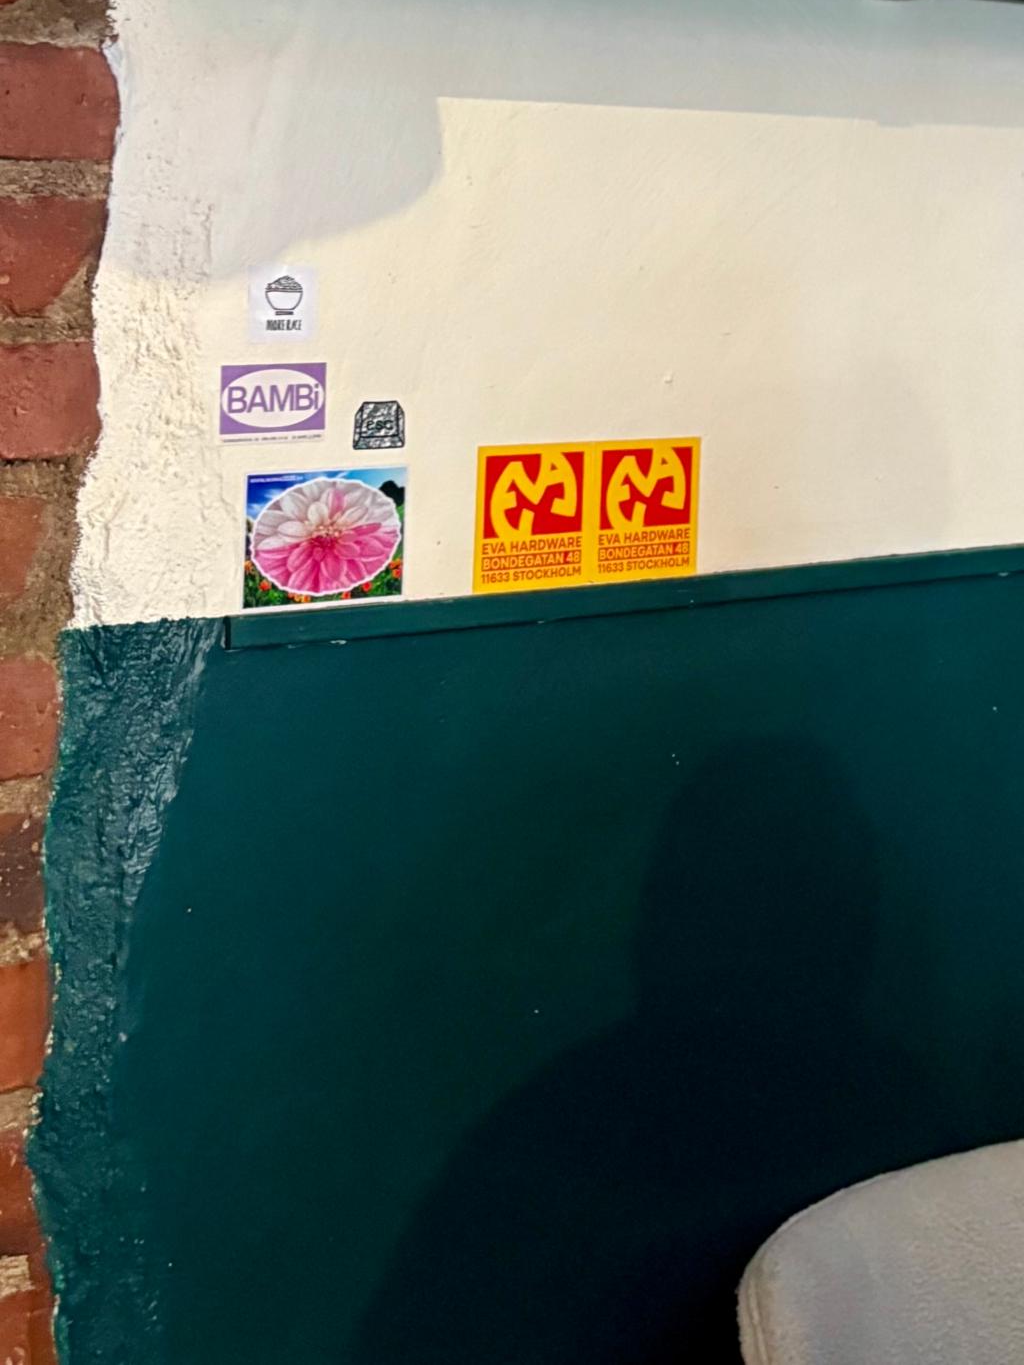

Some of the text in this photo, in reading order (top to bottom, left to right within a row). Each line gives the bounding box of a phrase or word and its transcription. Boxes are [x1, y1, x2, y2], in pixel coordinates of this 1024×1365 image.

[481, 536, 583, 555] EVA HARDWARE
[598, 528, 690, 546] EVA HARDWARE
[483, 550, 580, 571] BONDEGATAN 48
[599, 542, 689, 561] BONDEGATAN 48
[598, 556, 690, 574] 11633 STOCKHOLM
[481, 566, 582, 584] 11633 STOCKHOLM
